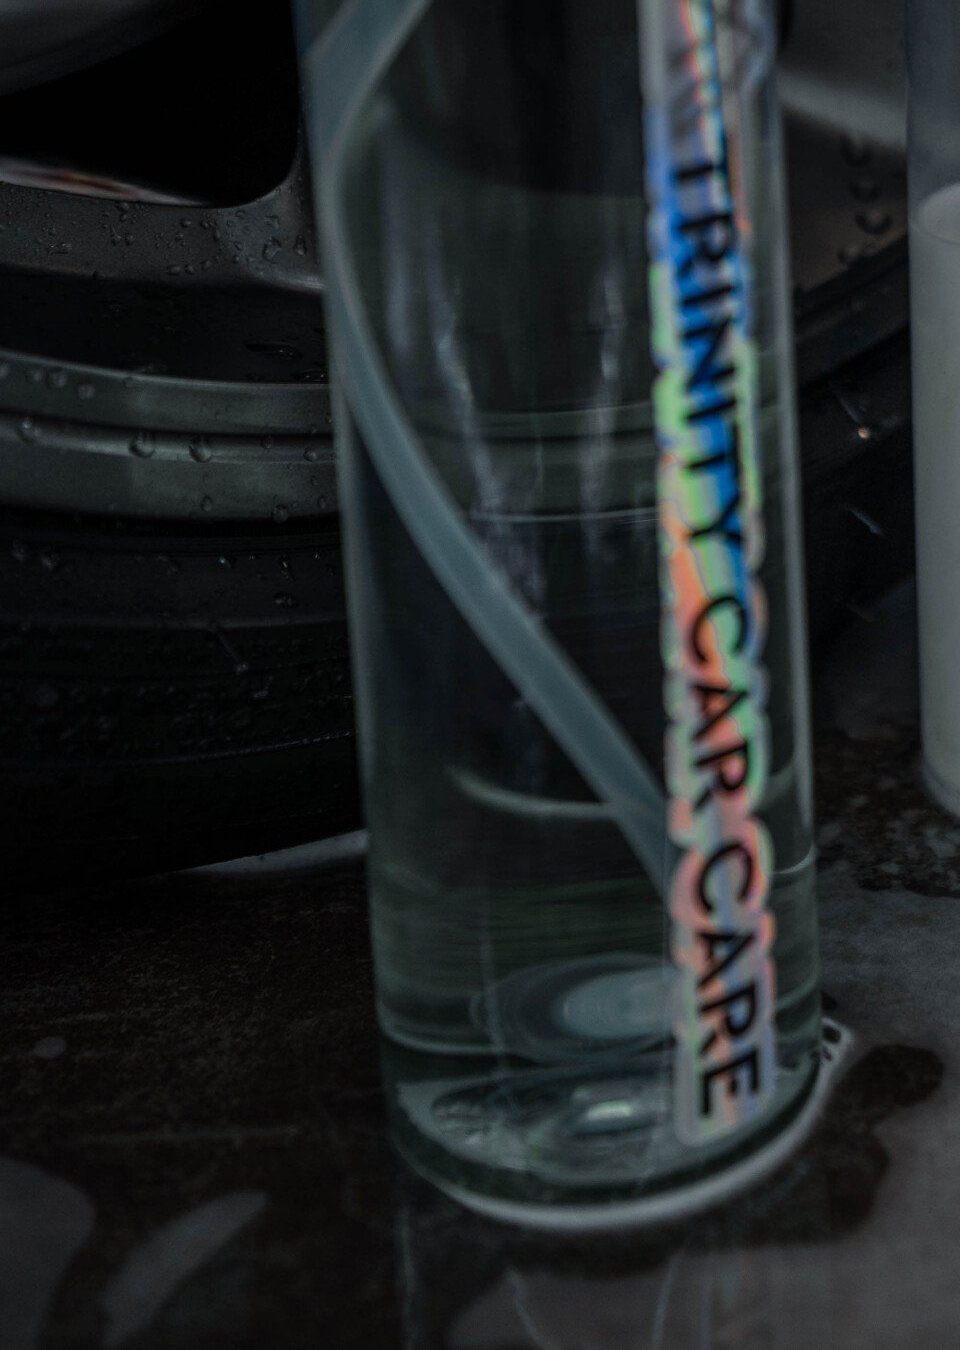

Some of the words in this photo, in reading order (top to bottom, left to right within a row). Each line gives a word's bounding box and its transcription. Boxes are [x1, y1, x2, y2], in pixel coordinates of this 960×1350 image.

[674, 122, 741, 542] TRINITY
[692, 595, 750, 810] CAR
[697, 844, 759, 1116] CARE
